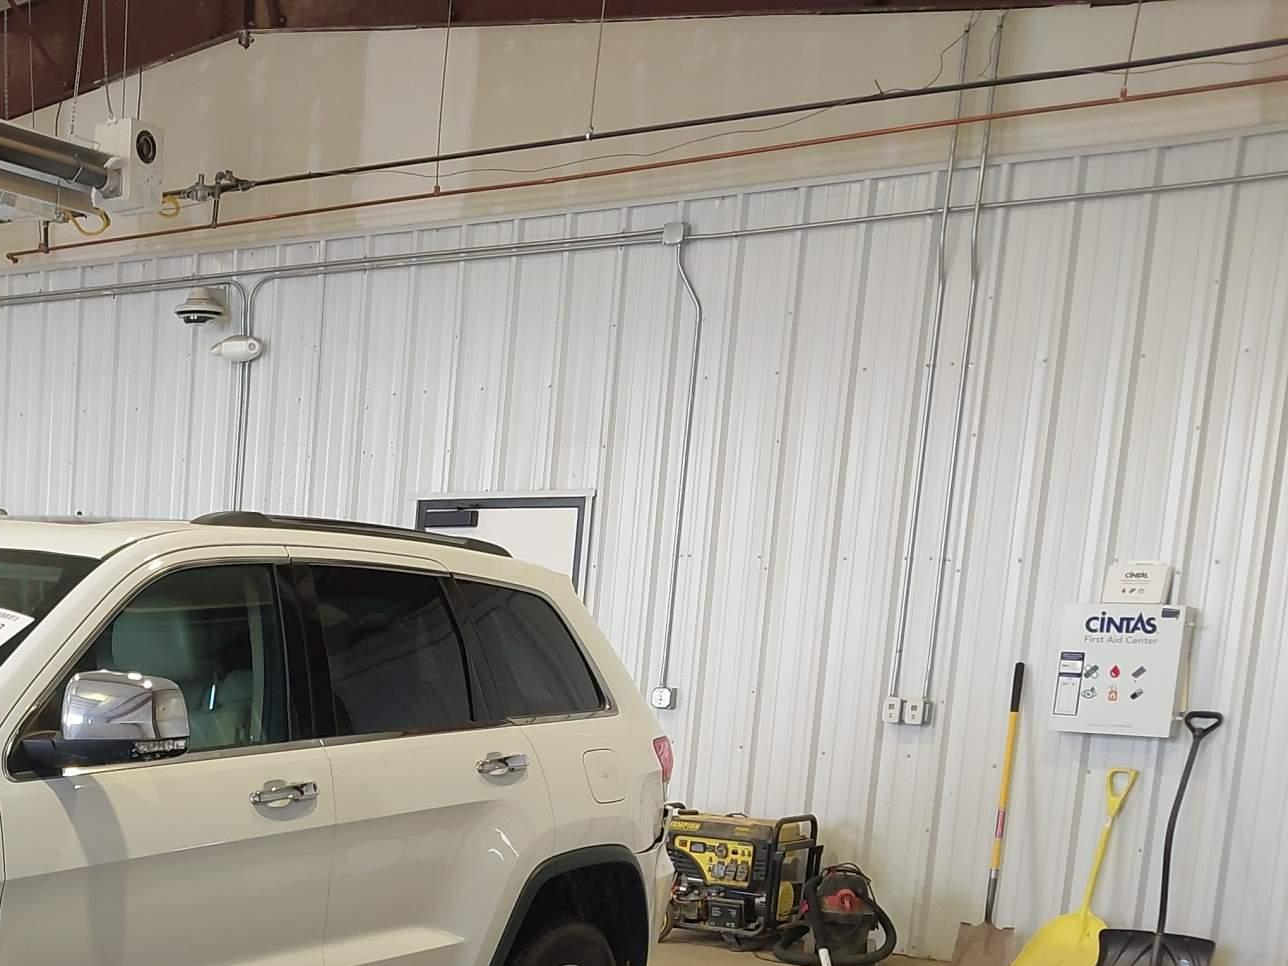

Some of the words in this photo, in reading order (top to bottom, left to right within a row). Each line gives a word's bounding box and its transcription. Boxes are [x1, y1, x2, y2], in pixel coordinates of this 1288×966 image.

[1085, 611, 1157, 634] CINTAS
[1084, 635, 1104, 644] First
[1107, 636, 1123, 644] Aid
[1125, 636, 1158, 645] Center
